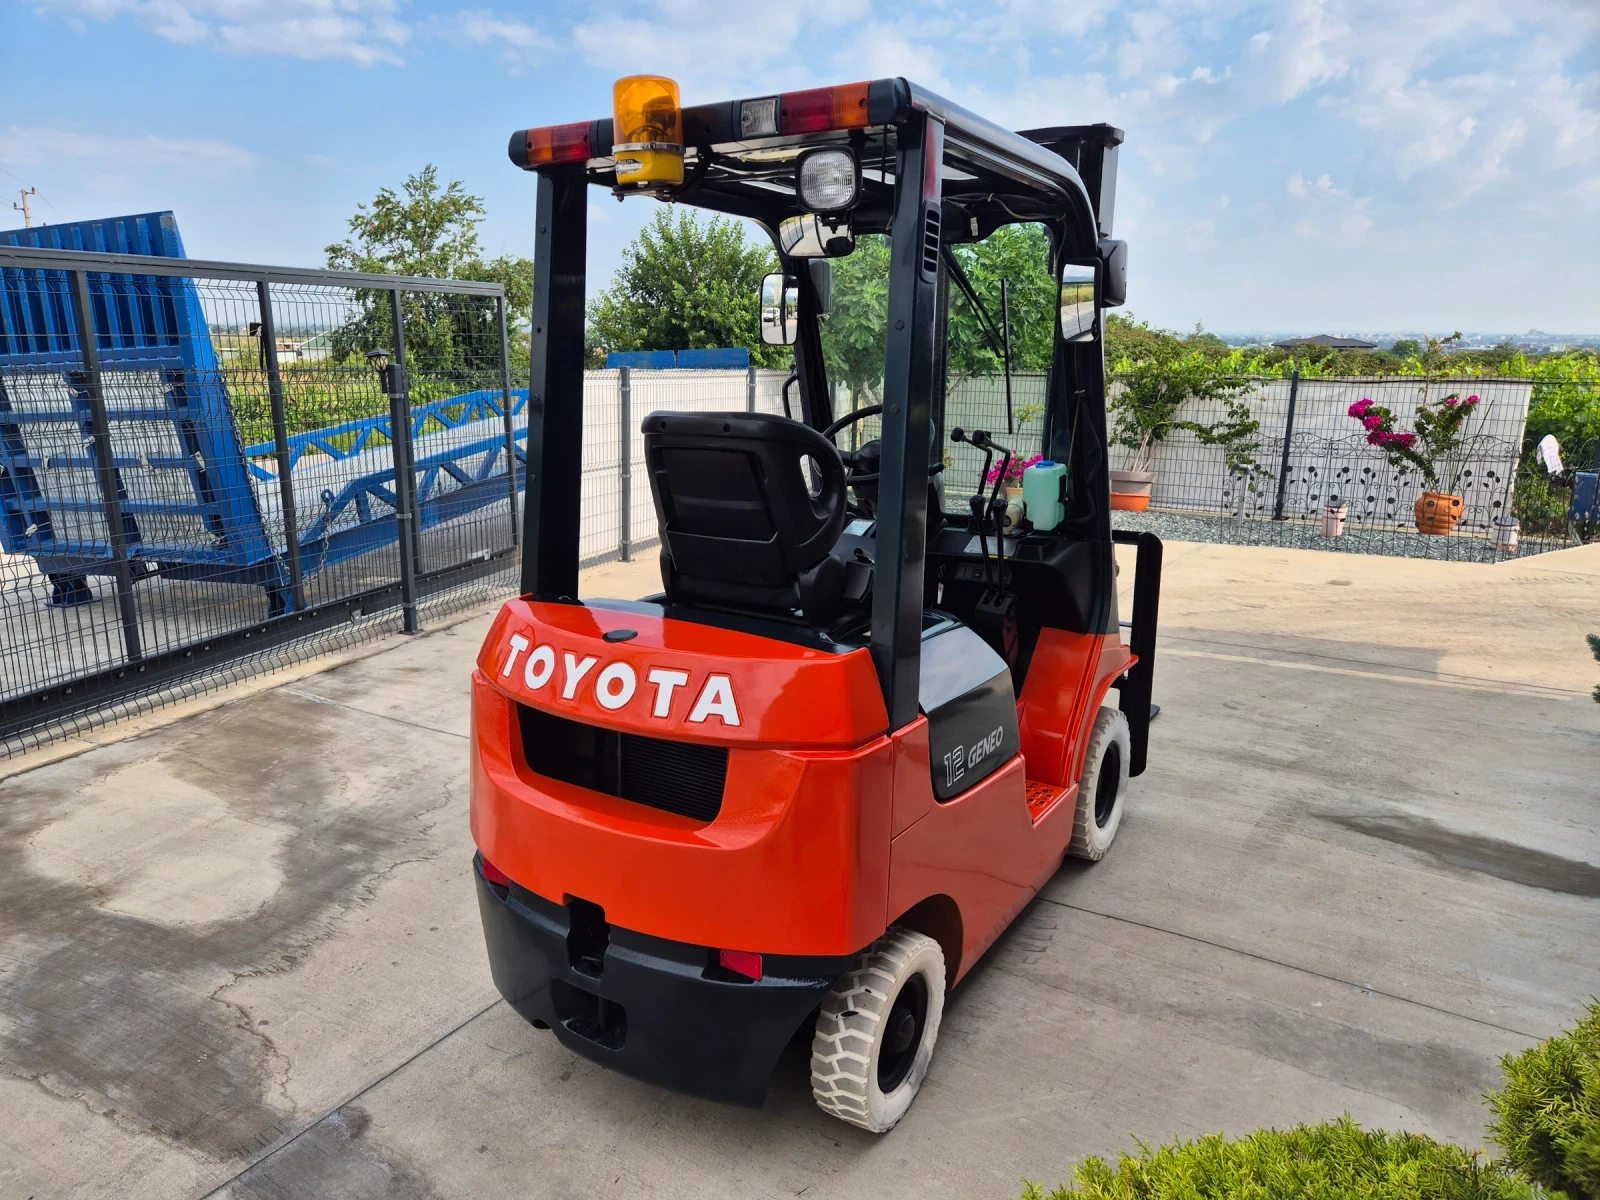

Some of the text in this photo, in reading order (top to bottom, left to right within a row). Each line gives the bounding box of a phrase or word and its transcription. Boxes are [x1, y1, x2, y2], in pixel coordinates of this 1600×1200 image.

[502, 633, 741, 727] TOYOTA
[943, 725, 1004, 787] 12 GENEO
